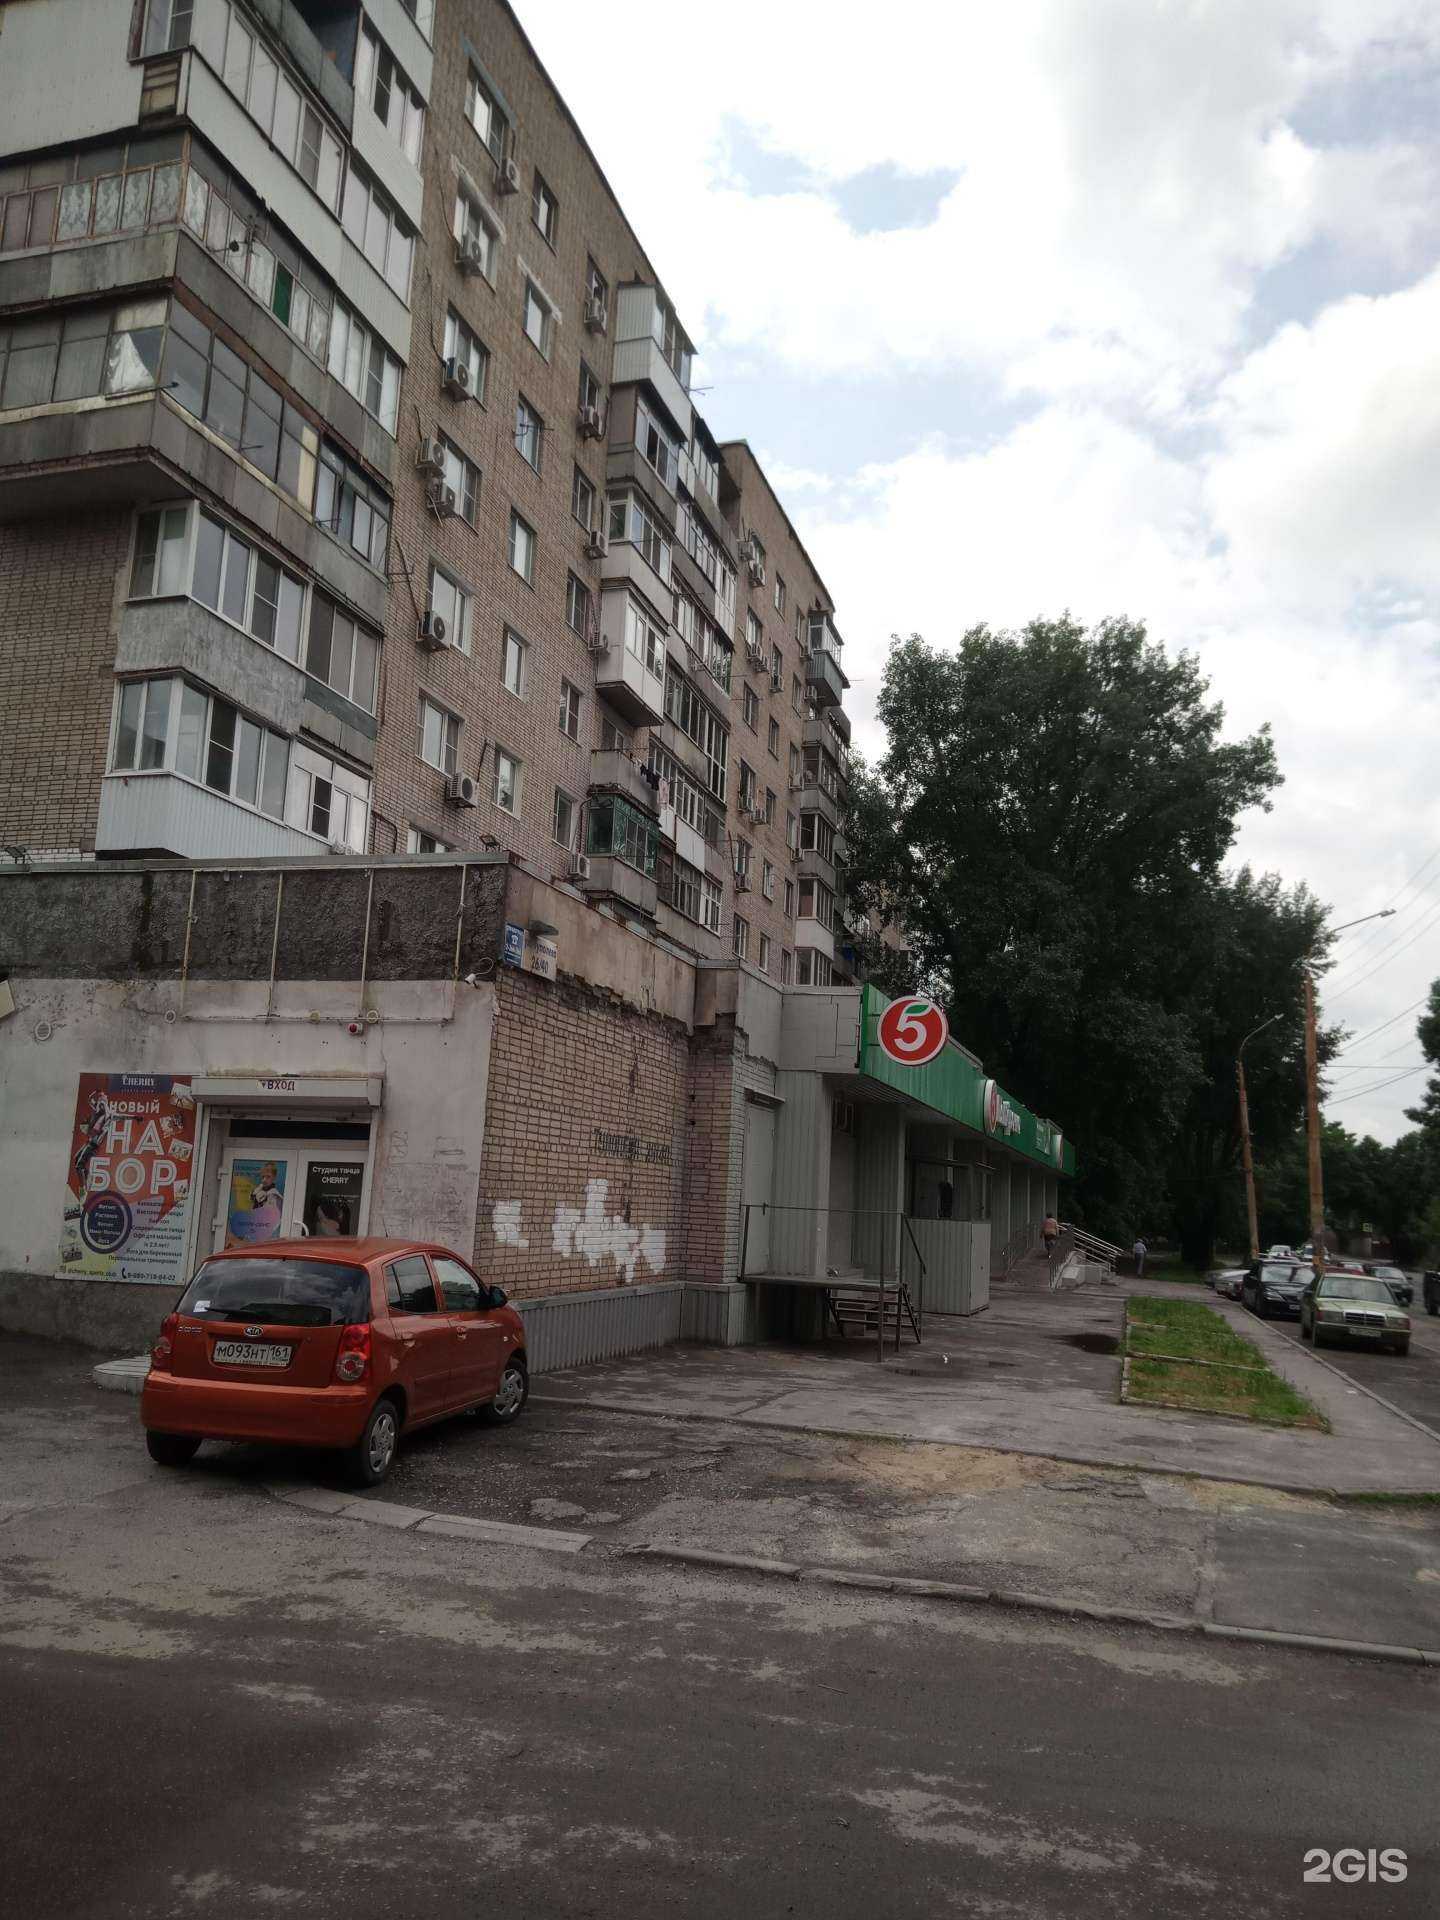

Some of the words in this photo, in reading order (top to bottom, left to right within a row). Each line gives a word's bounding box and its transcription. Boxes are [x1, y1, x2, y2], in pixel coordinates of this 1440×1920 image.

[893, 1000, 931, 1052] 5
[122, 1075, 154, 1087] CHERRY
[268, 1080, 295, 1091] ВХОД
[110, 1097, 160, 1114] НОВЫЙ
[106, 1118, 165, 1155] НА
[88, 1156, 177, 1195] БОР
[321, 1176, 350, 1184] CHERRY
[245, 1327, 261, 1336] KIA
[271, 1345, 289, 1358] 161
